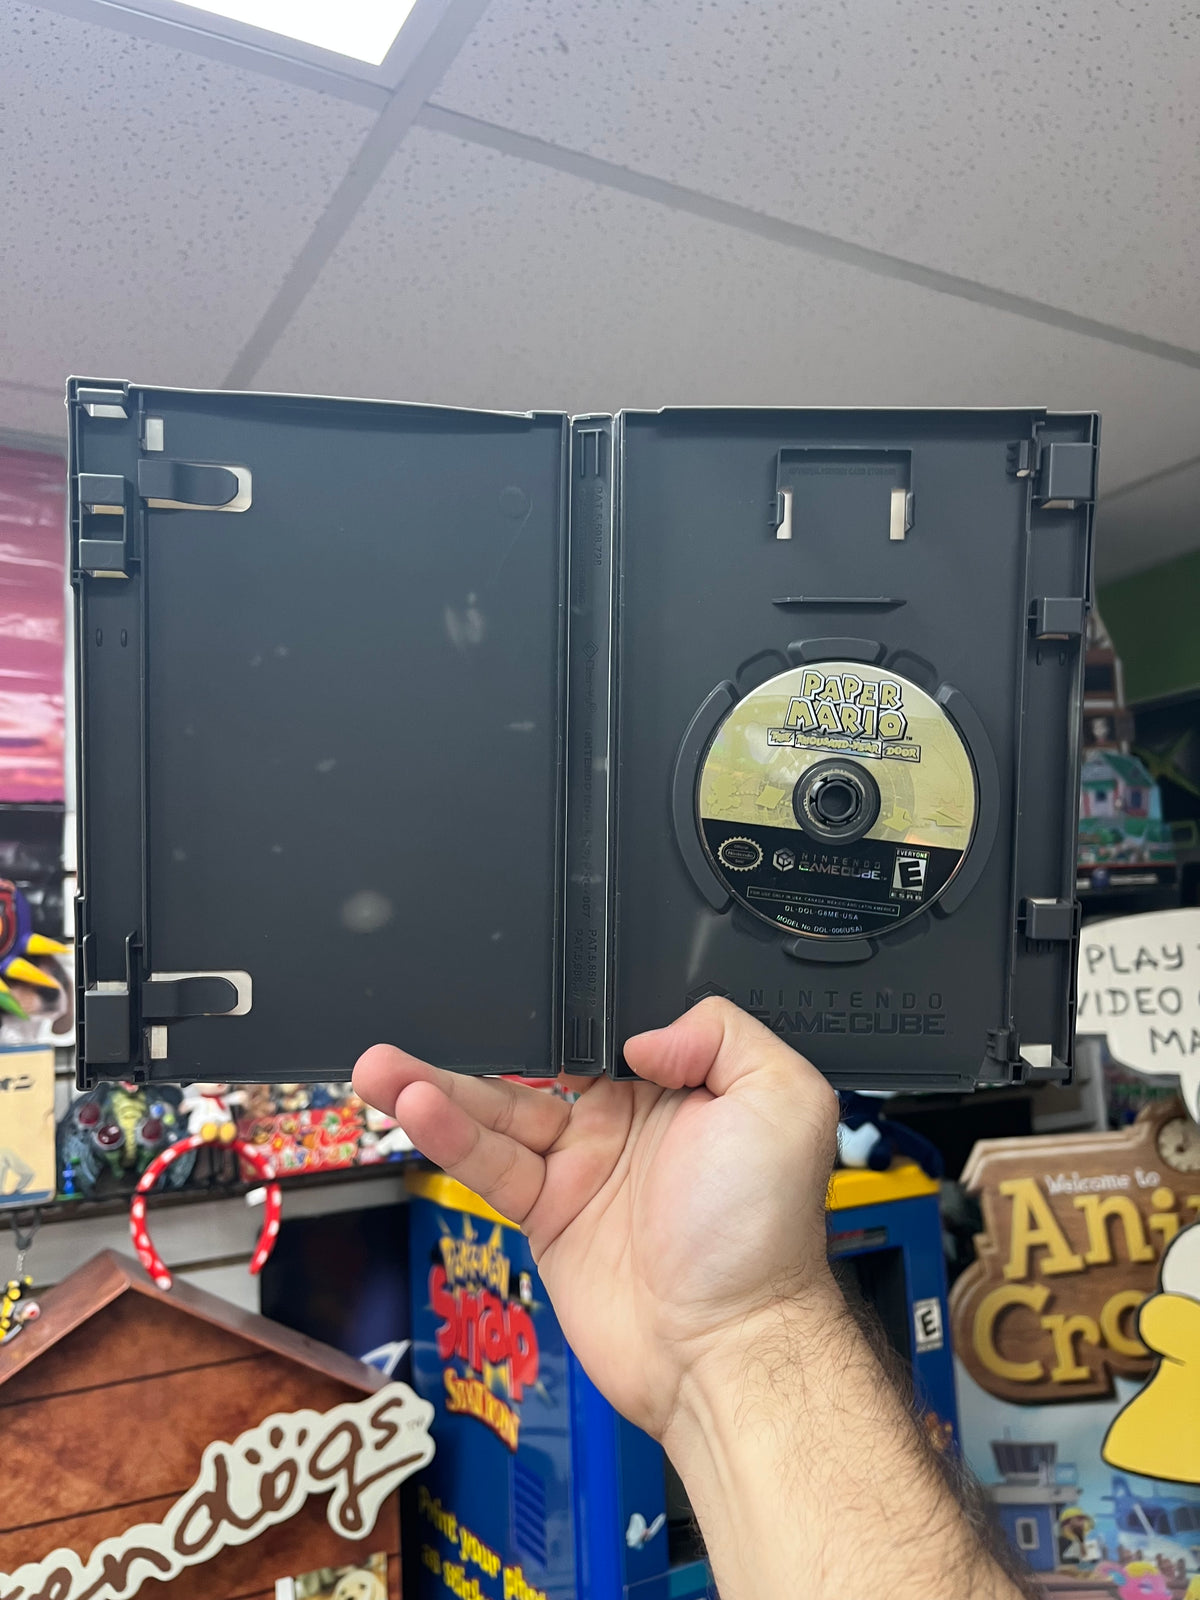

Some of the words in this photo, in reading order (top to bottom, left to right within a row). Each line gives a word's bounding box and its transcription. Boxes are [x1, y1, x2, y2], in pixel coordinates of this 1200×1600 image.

[801, 670, 904, 710] PAPER
[784, 696, 908, 741] MARIO
[885, 746, 918, 759] DOOR
[801, 852, 881, 870] NINTENDO
[896, 850, 928, 859] EVERYONE
[799, 861, 881, 880] GAMECUBE
[899, 861, 923, 888] E
[776, 914, 799, 928] MODEL
[1085, 944, 1183, 974] PLAY
[750, 989, 943, 1009] NINTENDO
[1044, 1171, 1130, 1194] Welcome
[1134, 1167, 1161, 1187] to
[920, 1310, 937, 1337] E
